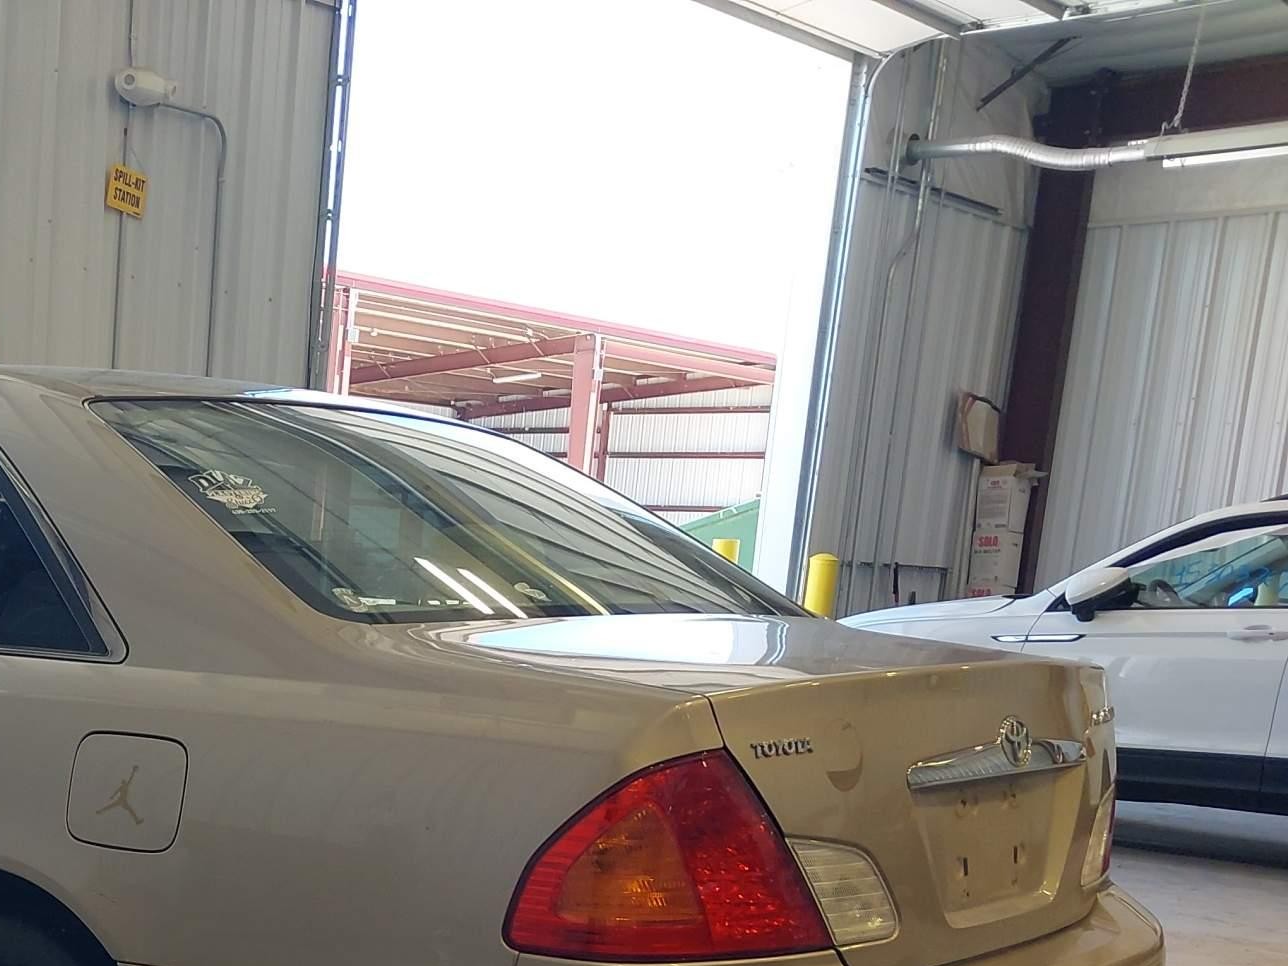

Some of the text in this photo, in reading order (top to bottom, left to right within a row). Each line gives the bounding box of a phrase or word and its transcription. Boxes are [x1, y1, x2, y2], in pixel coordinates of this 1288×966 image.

[114, 168, 146, 192] SPILL-KIT
[113, 187, 141, 208] STATION
[978, 535, 999, 548] SOLO
